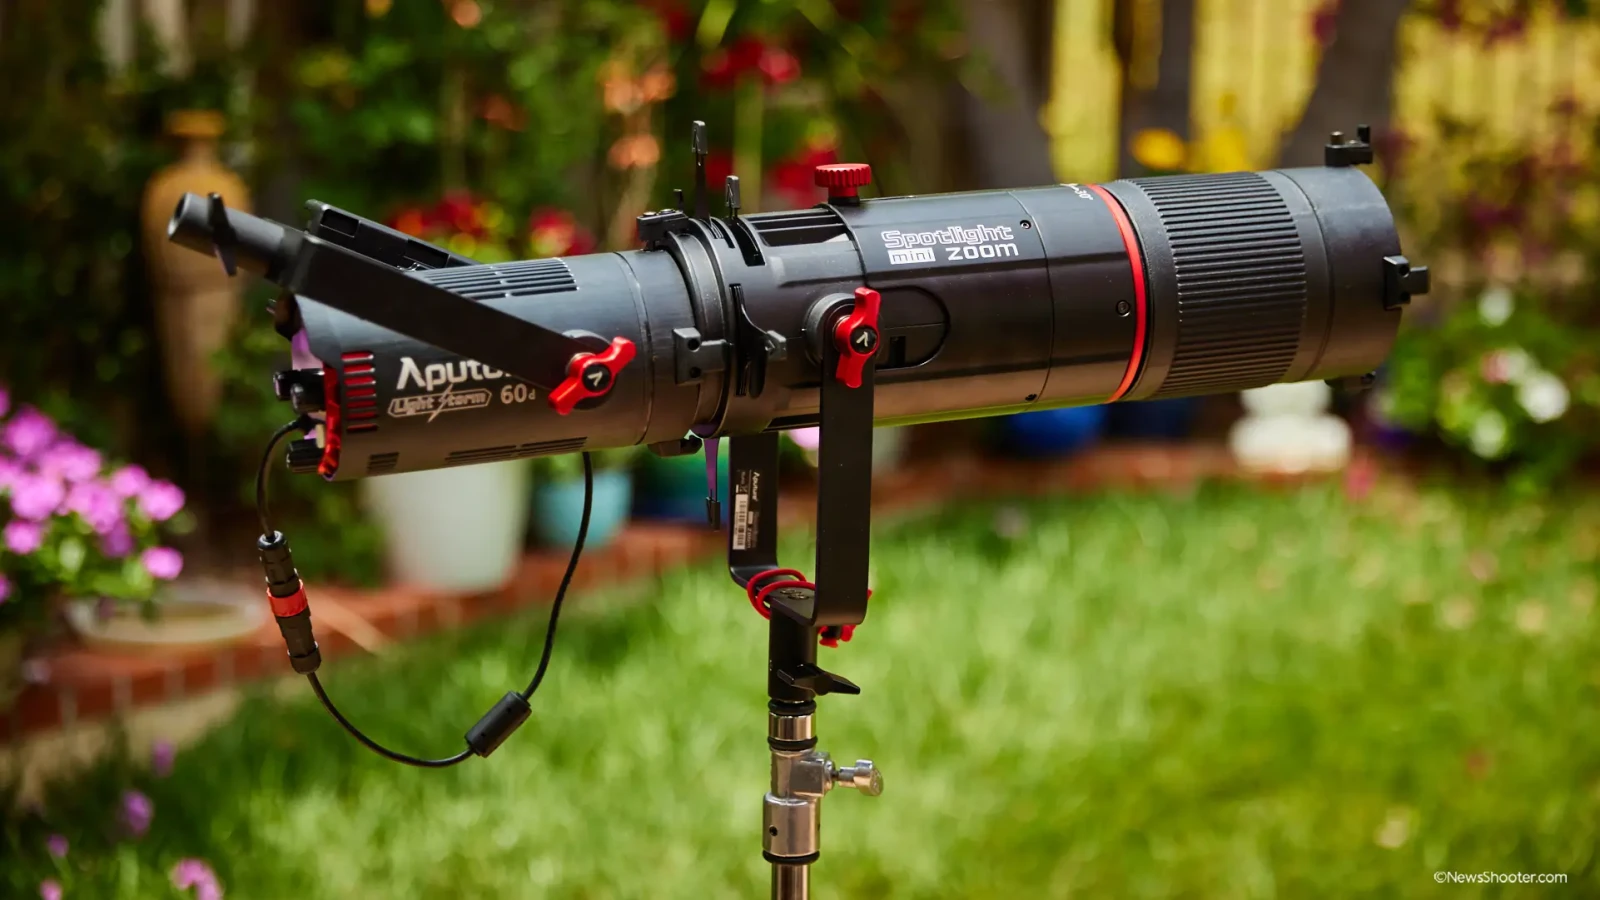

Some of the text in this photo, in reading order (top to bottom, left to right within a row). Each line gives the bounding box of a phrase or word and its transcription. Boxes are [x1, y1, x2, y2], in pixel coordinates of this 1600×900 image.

[881, 225, 1014, 248] Spotlight
[887, 243, 1019, 265] mini zoom
[397, 357, 511, 391] Aputu
